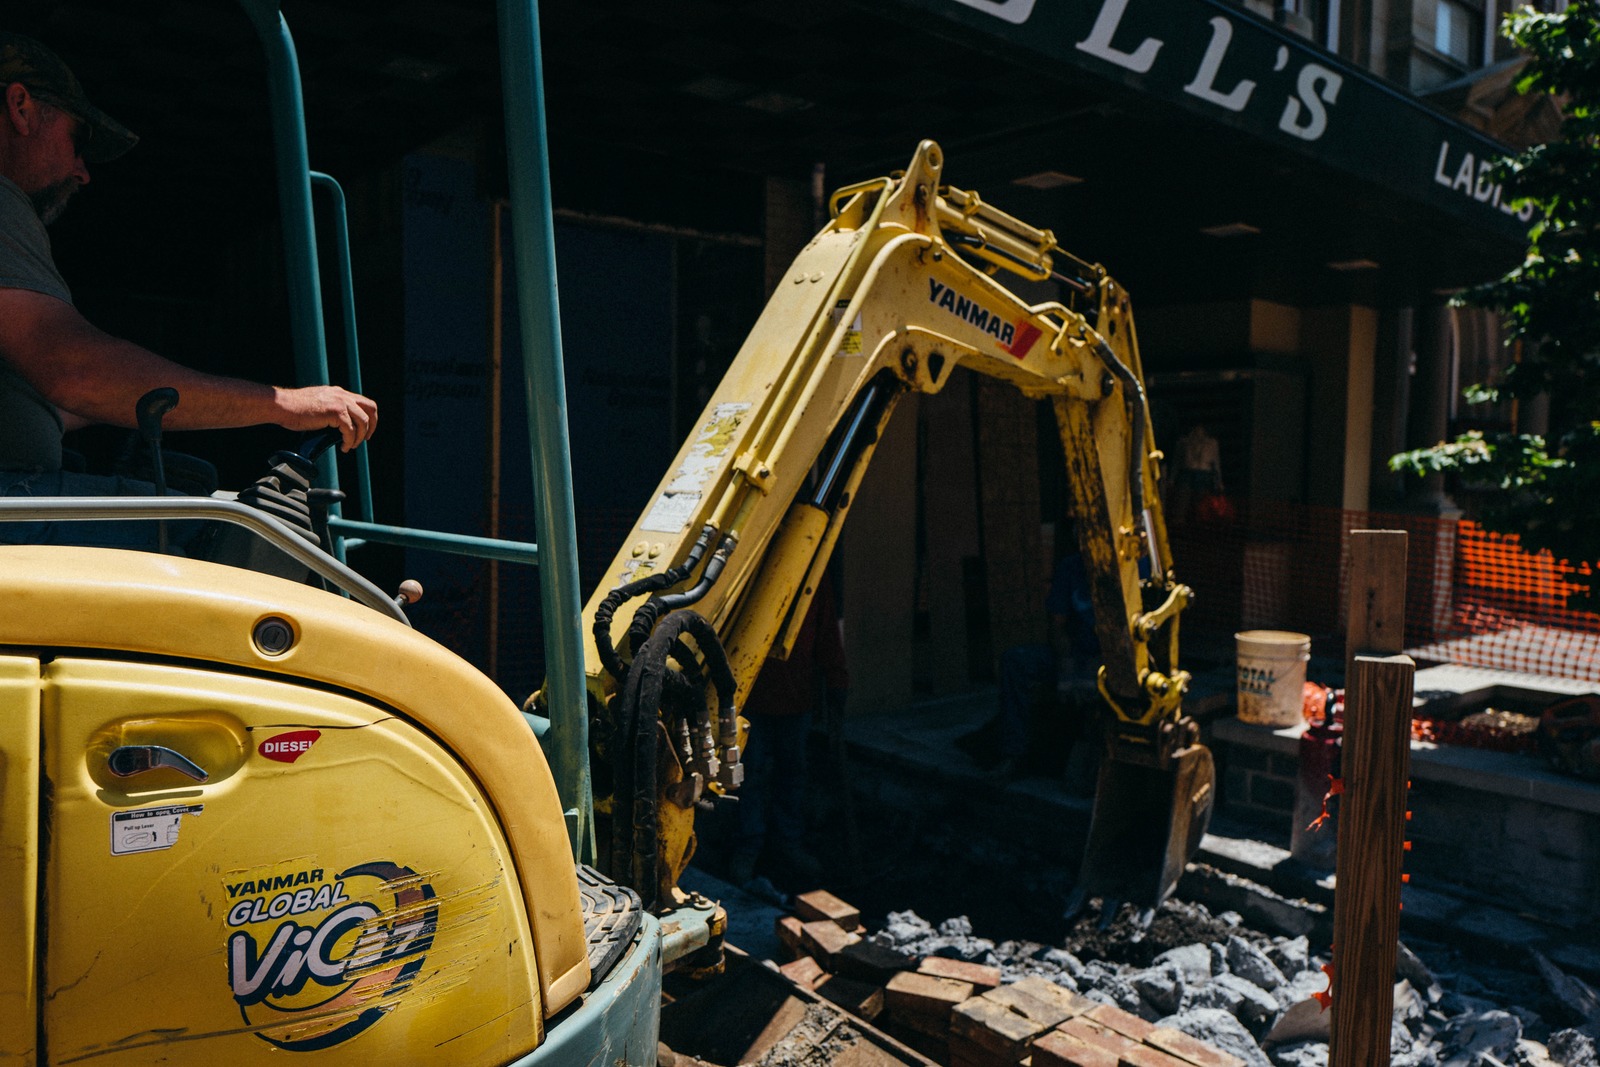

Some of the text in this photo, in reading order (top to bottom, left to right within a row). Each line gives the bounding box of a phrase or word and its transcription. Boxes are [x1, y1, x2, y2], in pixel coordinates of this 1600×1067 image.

[955, 0, 1343, 141] LL'S
[928, 277, 1016, 346] YANMAR
[130, 811, 145, 819] How
[226, 868, 324, 898] YANMAR
[227, 881, 350, 926] GLOBAL
